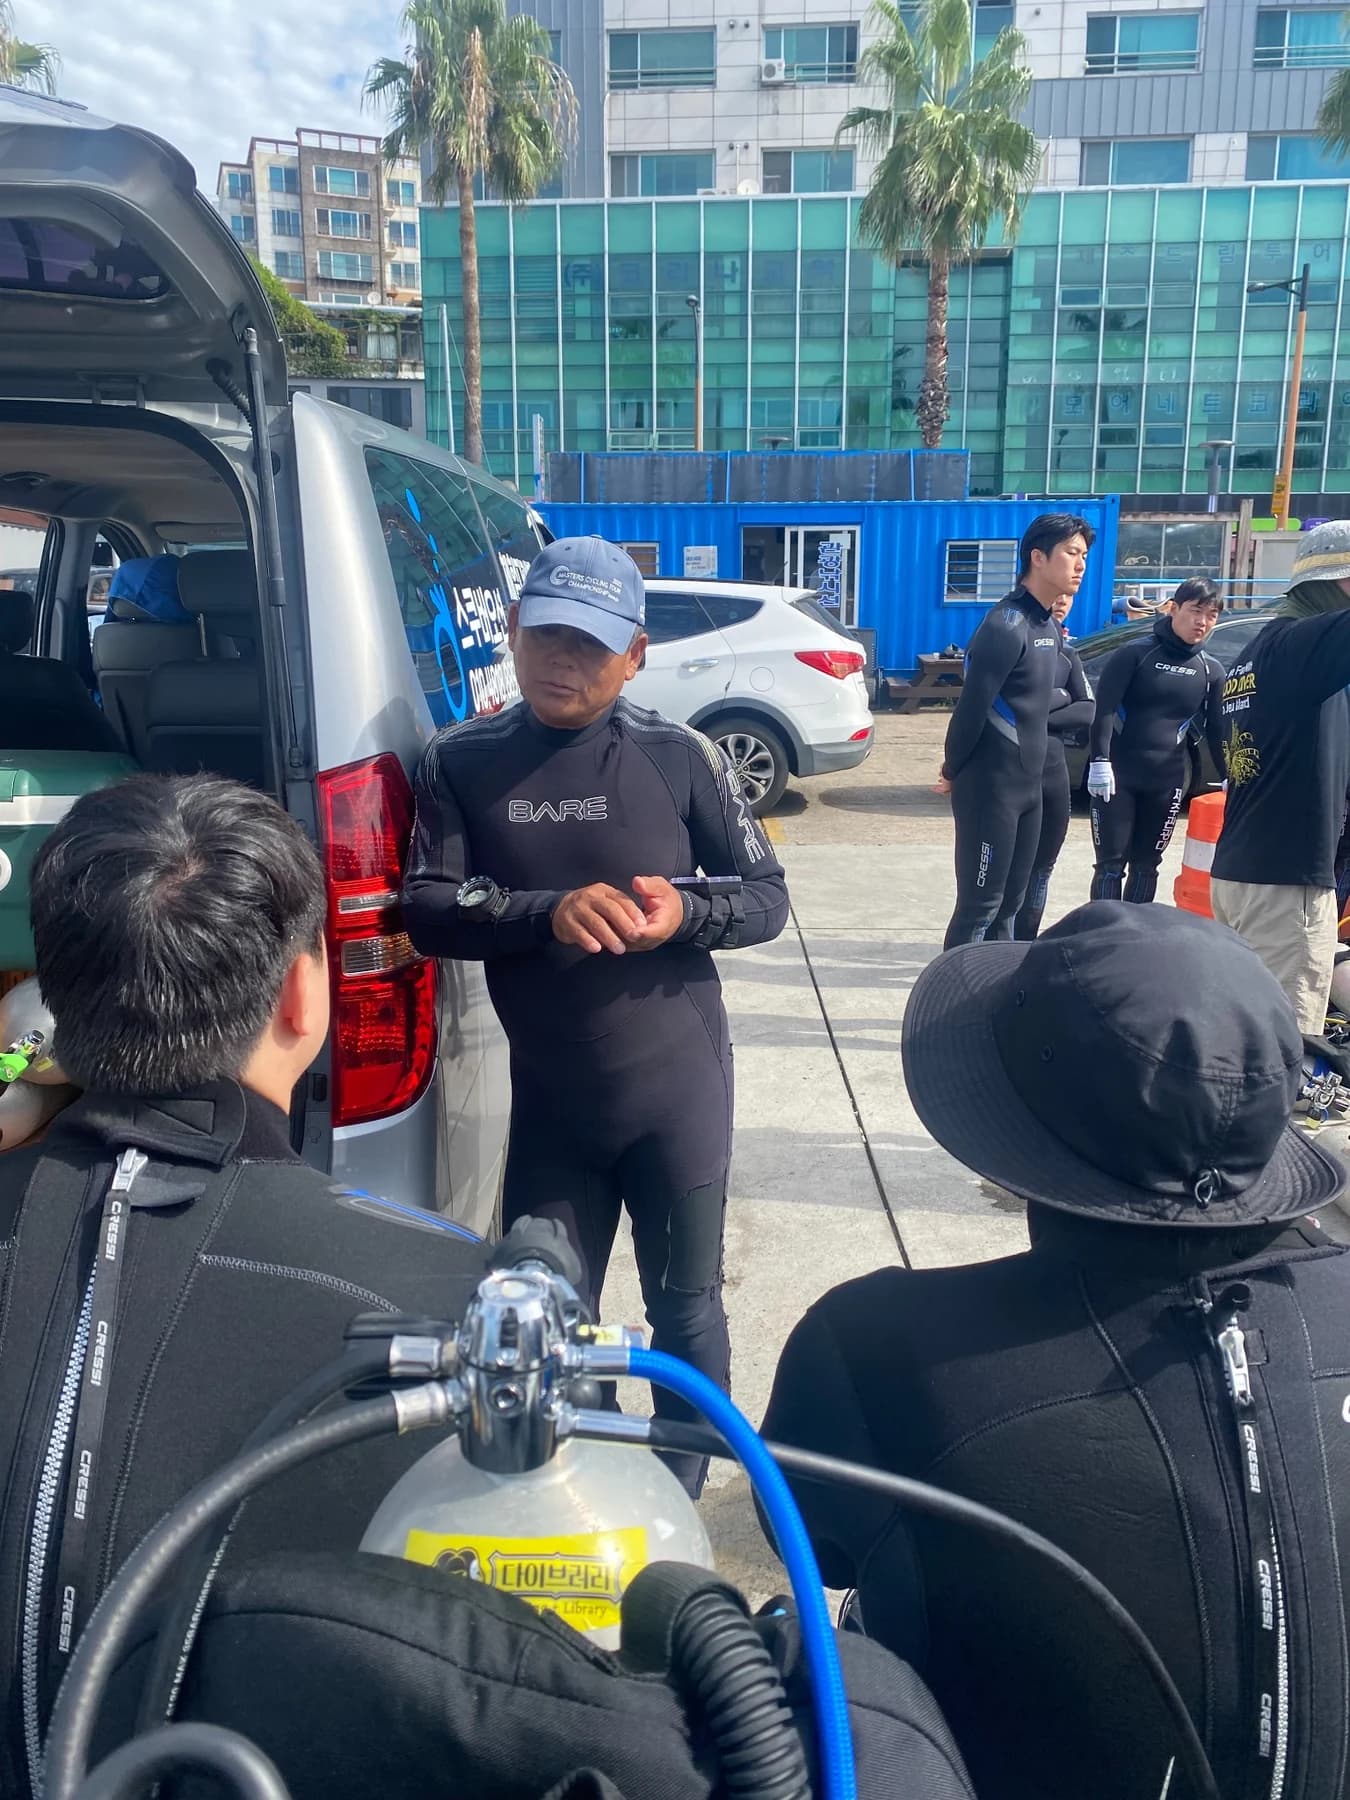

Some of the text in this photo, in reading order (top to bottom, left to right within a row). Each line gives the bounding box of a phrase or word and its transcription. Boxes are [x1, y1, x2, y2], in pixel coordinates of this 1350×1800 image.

[1154, 662, 1197, 676] CRESSI
[508, 795, 608, 823] BARE
[725, 769, 766, 864] BARE
[976, 841, 991, 888] CRESSI
[105, 1200, 122, 1261] CRESSI
[90, 1320, 108, 1387] CRESSI
[73, 1449, 92, 1520] CRESSI
[1244, 1424, 1262, 1494] CRESSI
[501, 1562, 610, 1591] 다이브러리
[563, 1600, 608, 1618] Library
[1257, 1559, 1273, 1631] CRESSI
[58, 1586, 75, 1653] CRESSI
[1258, 1693, 1272, 1758] CRESSI
